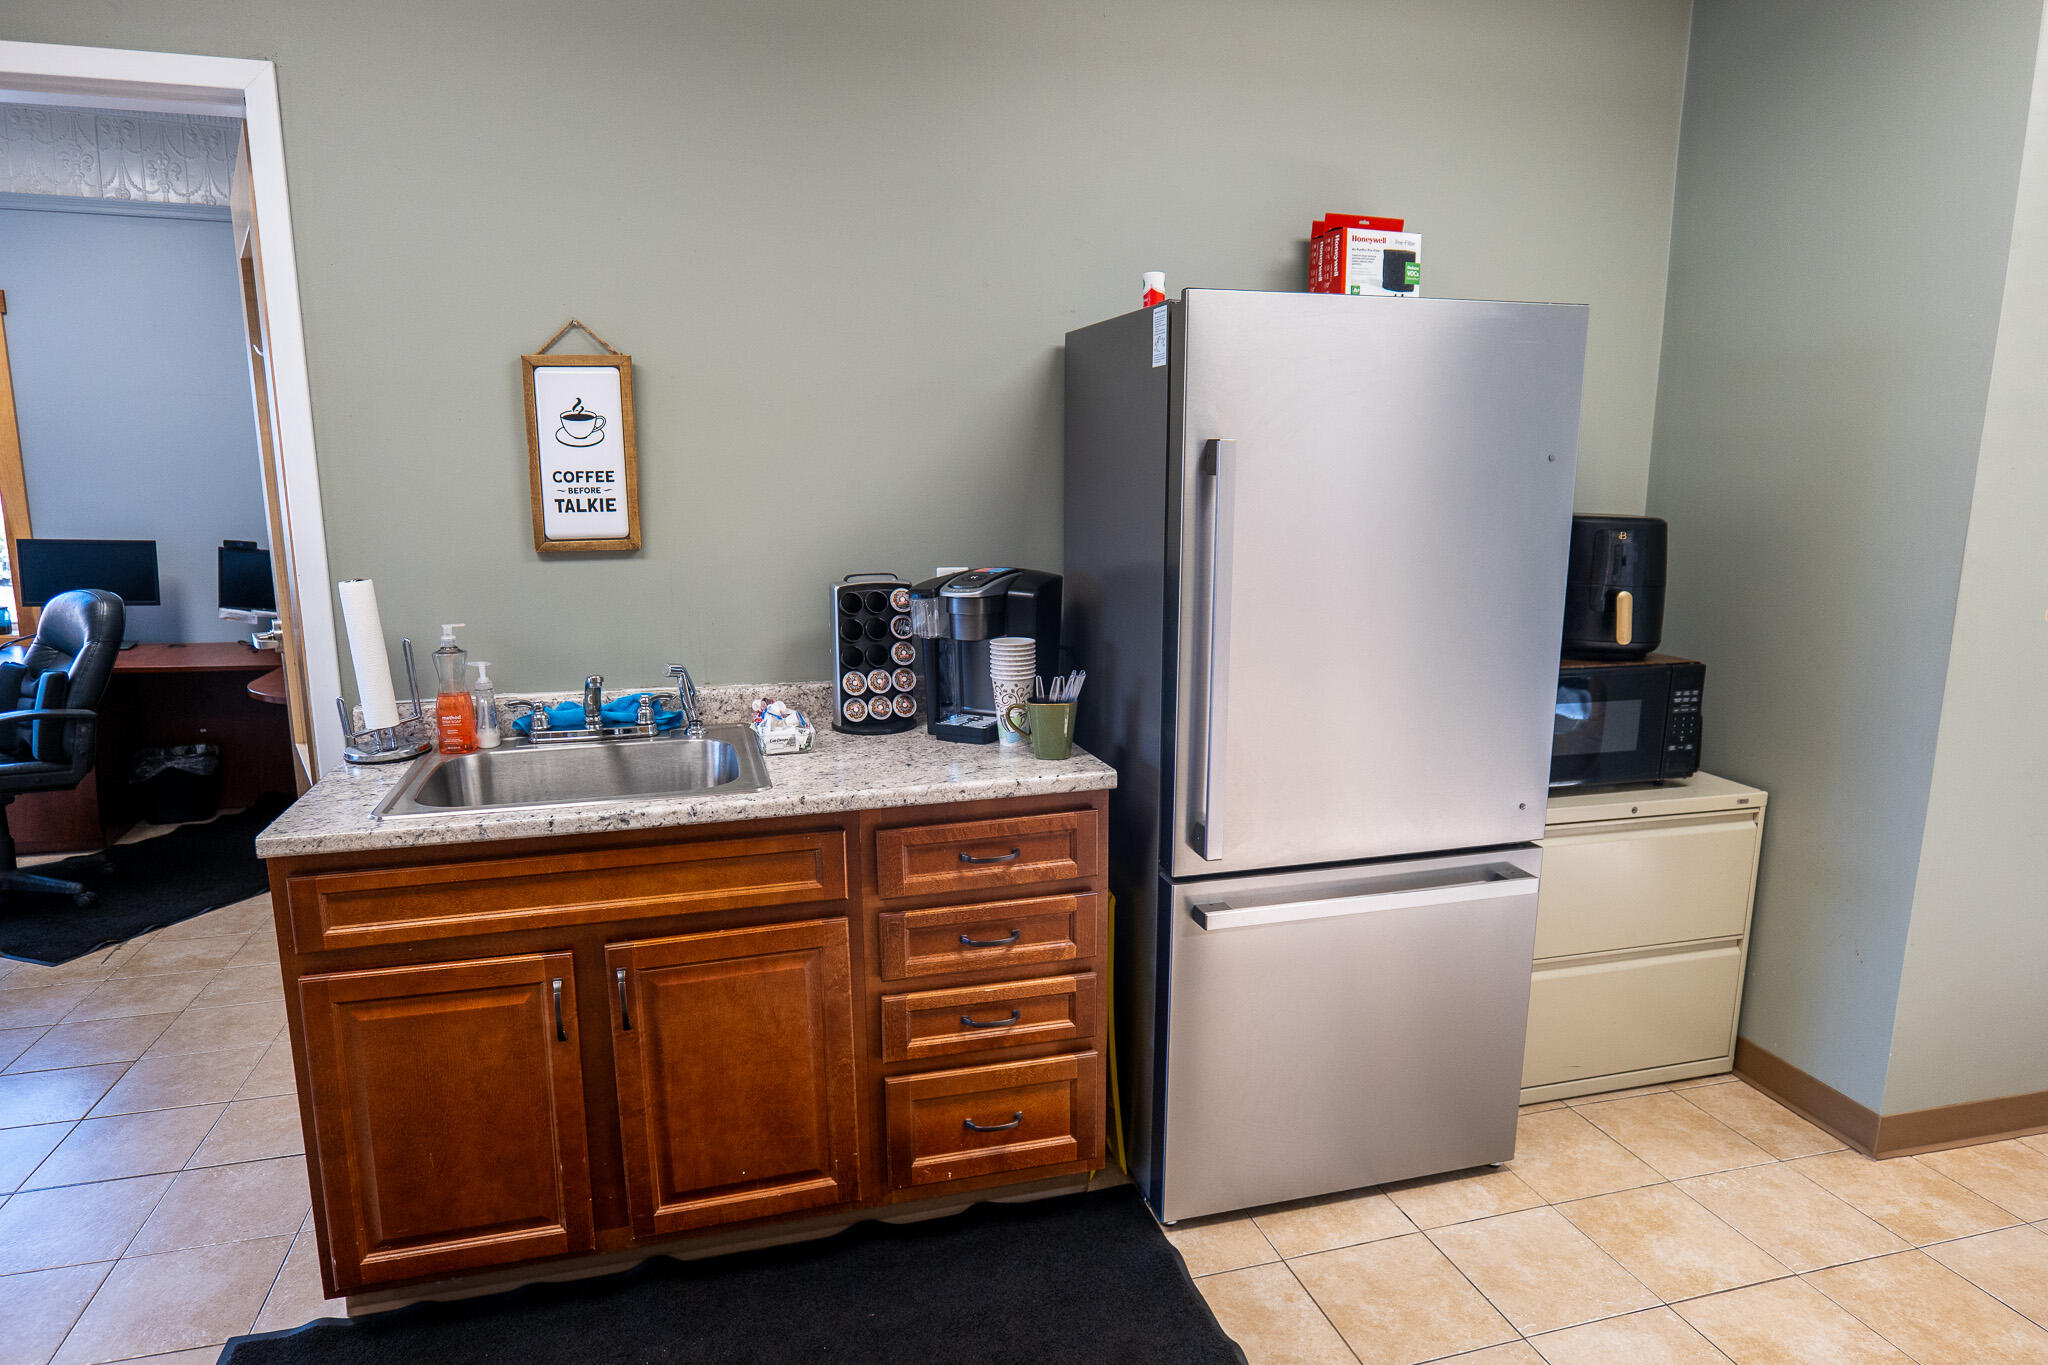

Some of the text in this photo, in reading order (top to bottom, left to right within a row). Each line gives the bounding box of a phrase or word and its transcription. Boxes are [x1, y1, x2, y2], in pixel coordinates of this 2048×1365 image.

[1351, 234, 1387, 245] Honeywell
[552, 470, 615, 483] COFFEE
[568, 486, 602, 494] BEFORE
[554, 498, 617, 513] TALKIE
